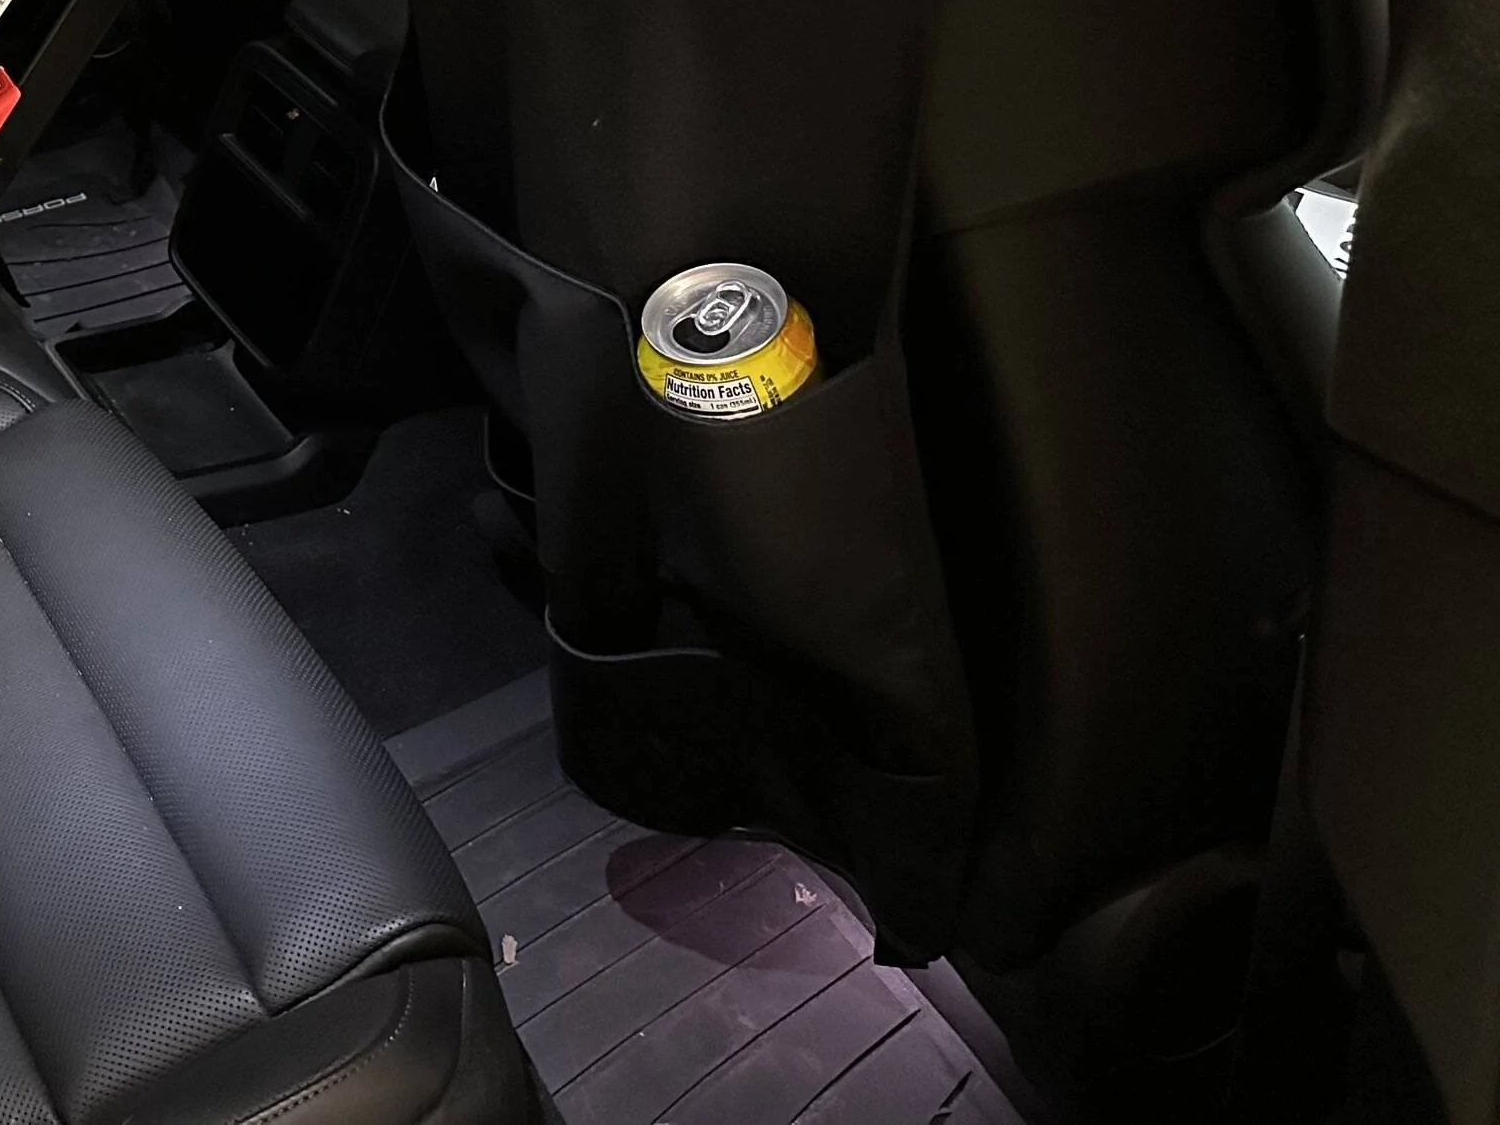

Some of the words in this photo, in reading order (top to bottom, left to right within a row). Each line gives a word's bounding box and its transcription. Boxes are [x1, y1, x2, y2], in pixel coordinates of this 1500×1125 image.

[673, 368, 705, 382] CONTAINS
[706, 374, 718, 382] 0%
[719, 370, 739, 381] JUICE
[667, 377, 715, 399] Nutrition
[718, 382, 752, 399] Facts
[688, 401, 701, 409] size
